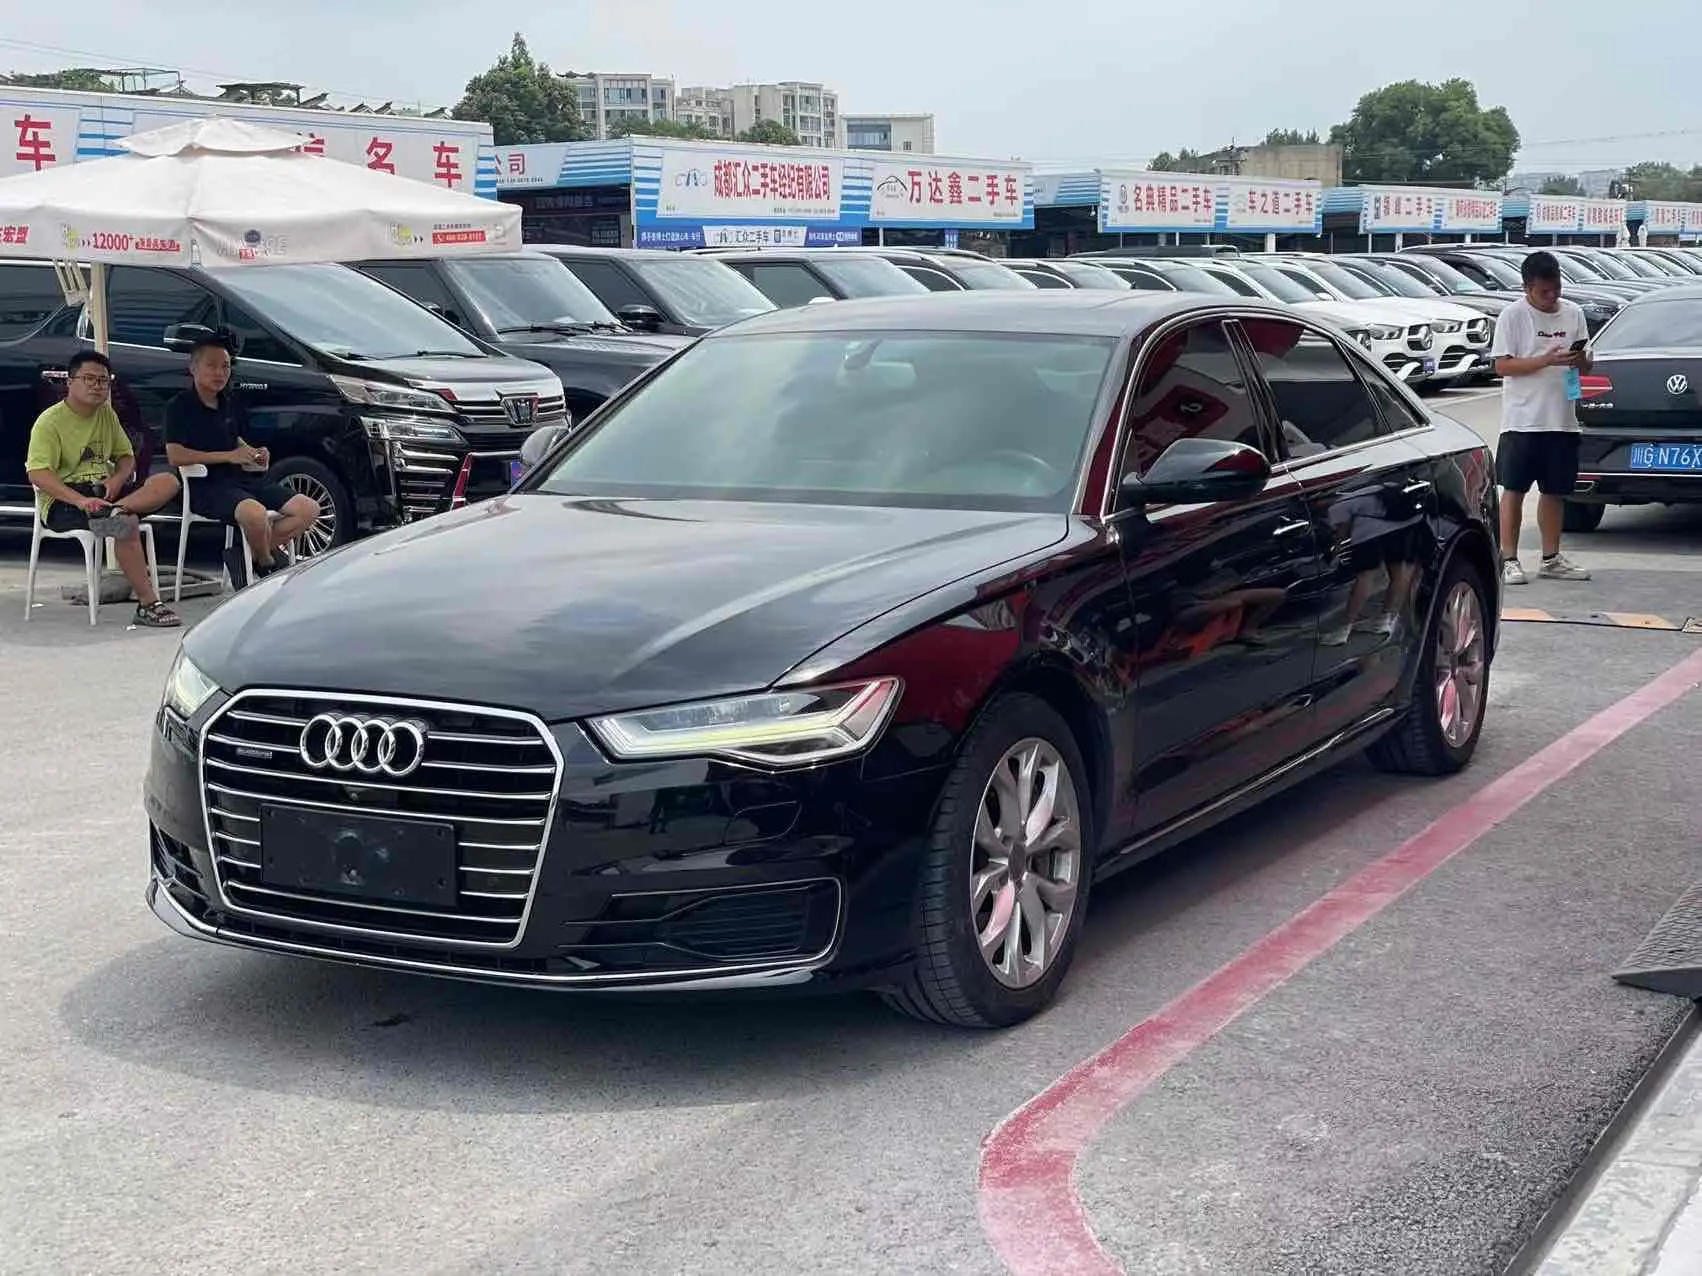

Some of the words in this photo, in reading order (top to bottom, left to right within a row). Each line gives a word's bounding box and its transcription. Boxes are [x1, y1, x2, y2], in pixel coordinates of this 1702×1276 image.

[14, 113, 57, 171] 车
[714, 159, 831, 201] 成都汇众二手车经纪有限公司
[908, 170, 1019, 207] 万达鑫二手车
